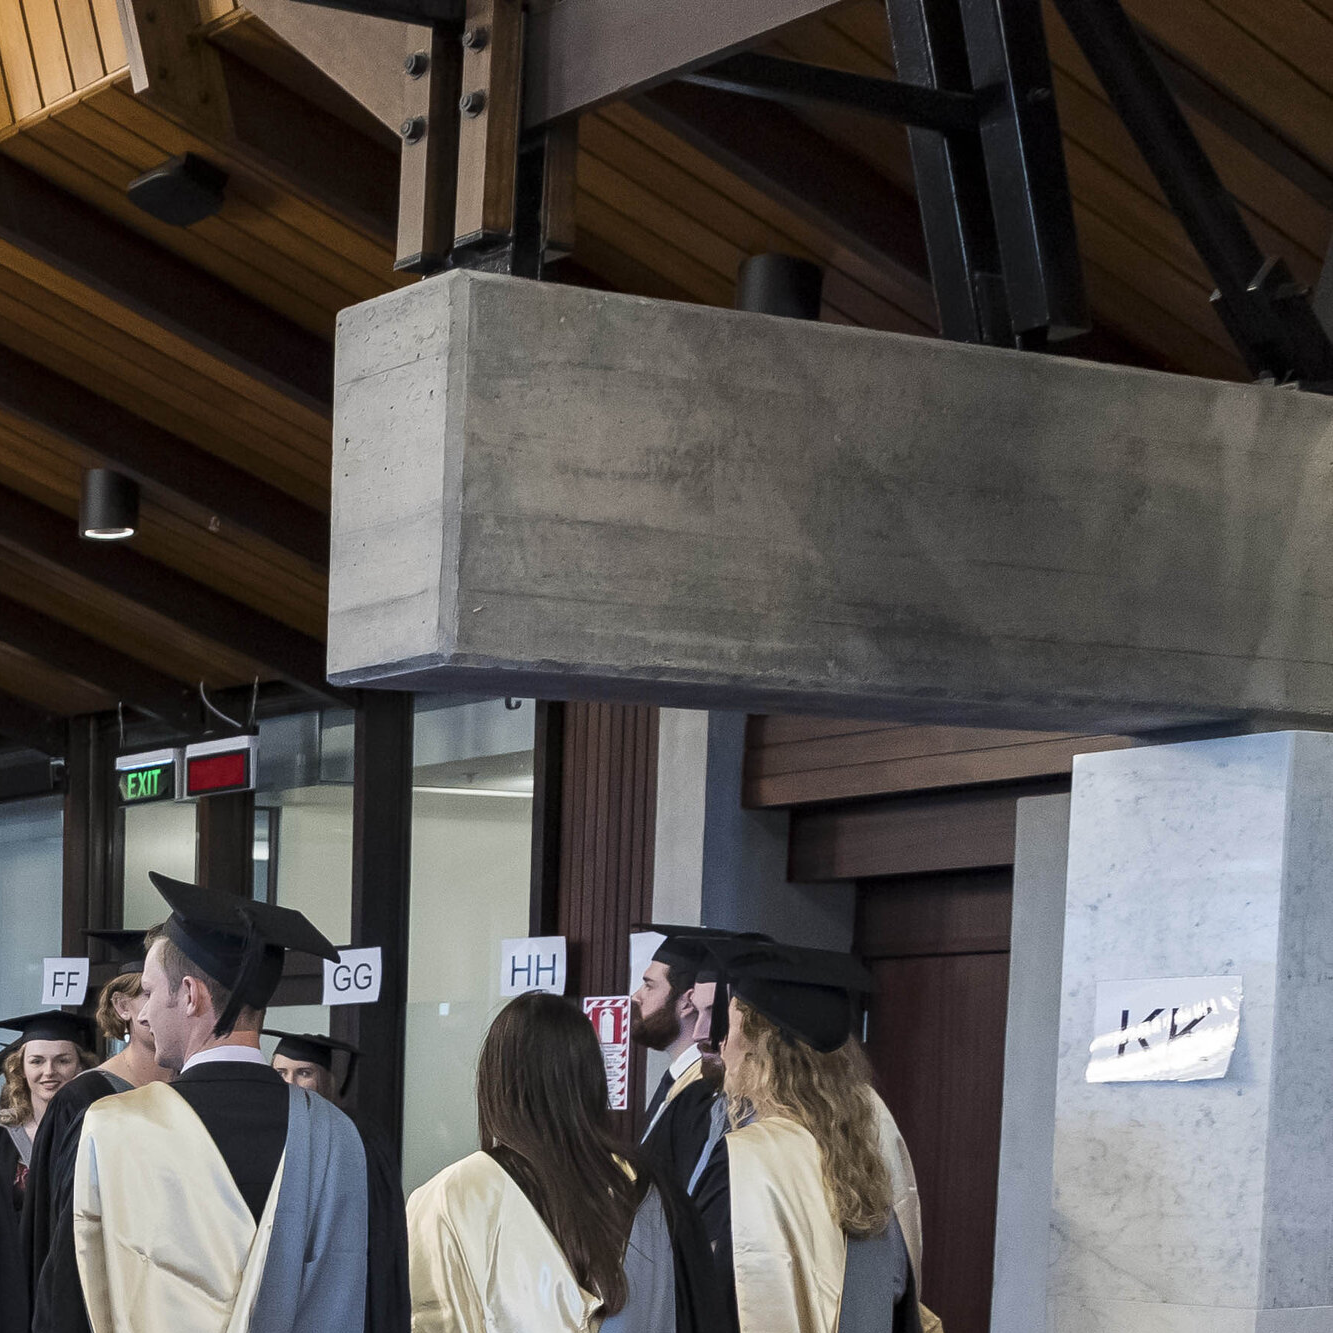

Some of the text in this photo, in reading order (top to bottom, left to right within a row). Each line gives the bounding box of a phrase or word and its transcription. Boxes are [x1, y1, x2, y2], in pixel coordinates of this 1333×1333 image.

[127, 768, 161, 799] EXIT
[52, 971, 80, 997] FF
[333, 963, 372, 991] GG
[511, 953, 556, 986] HH
